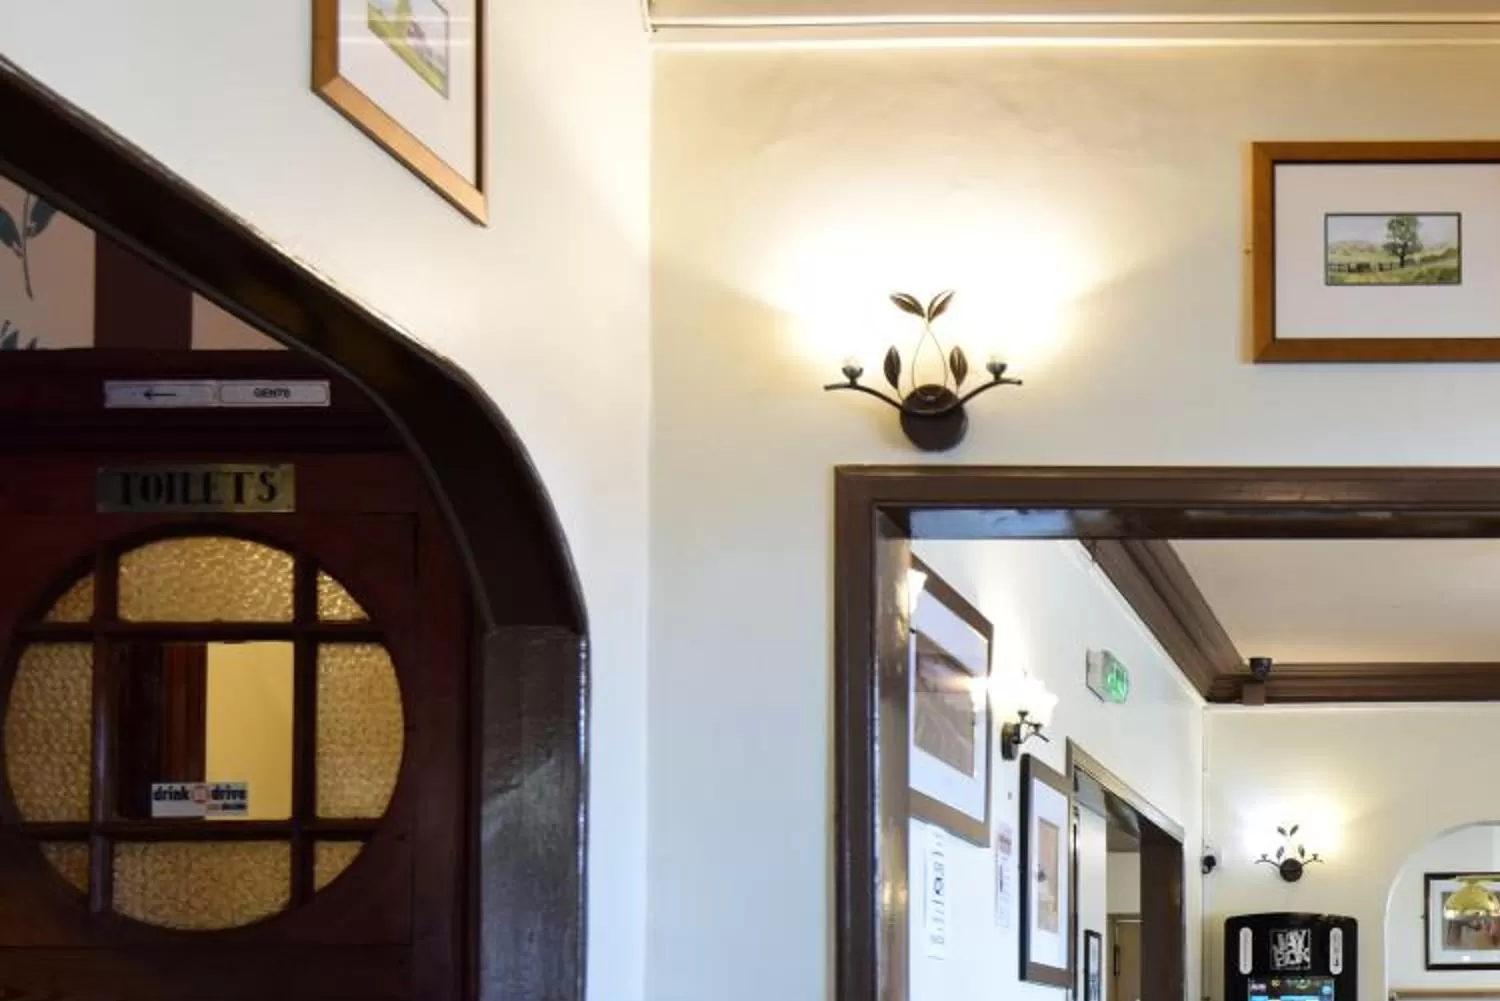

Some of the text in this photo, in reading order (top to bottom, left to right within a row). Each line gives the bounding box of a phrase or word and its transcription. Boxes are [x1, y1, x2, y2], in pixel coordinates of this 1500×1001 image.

[253, 387, 291, 398] GENTS
[116, 471, 278, 505] TOILETS
[154, 784, 190, 801] drink
